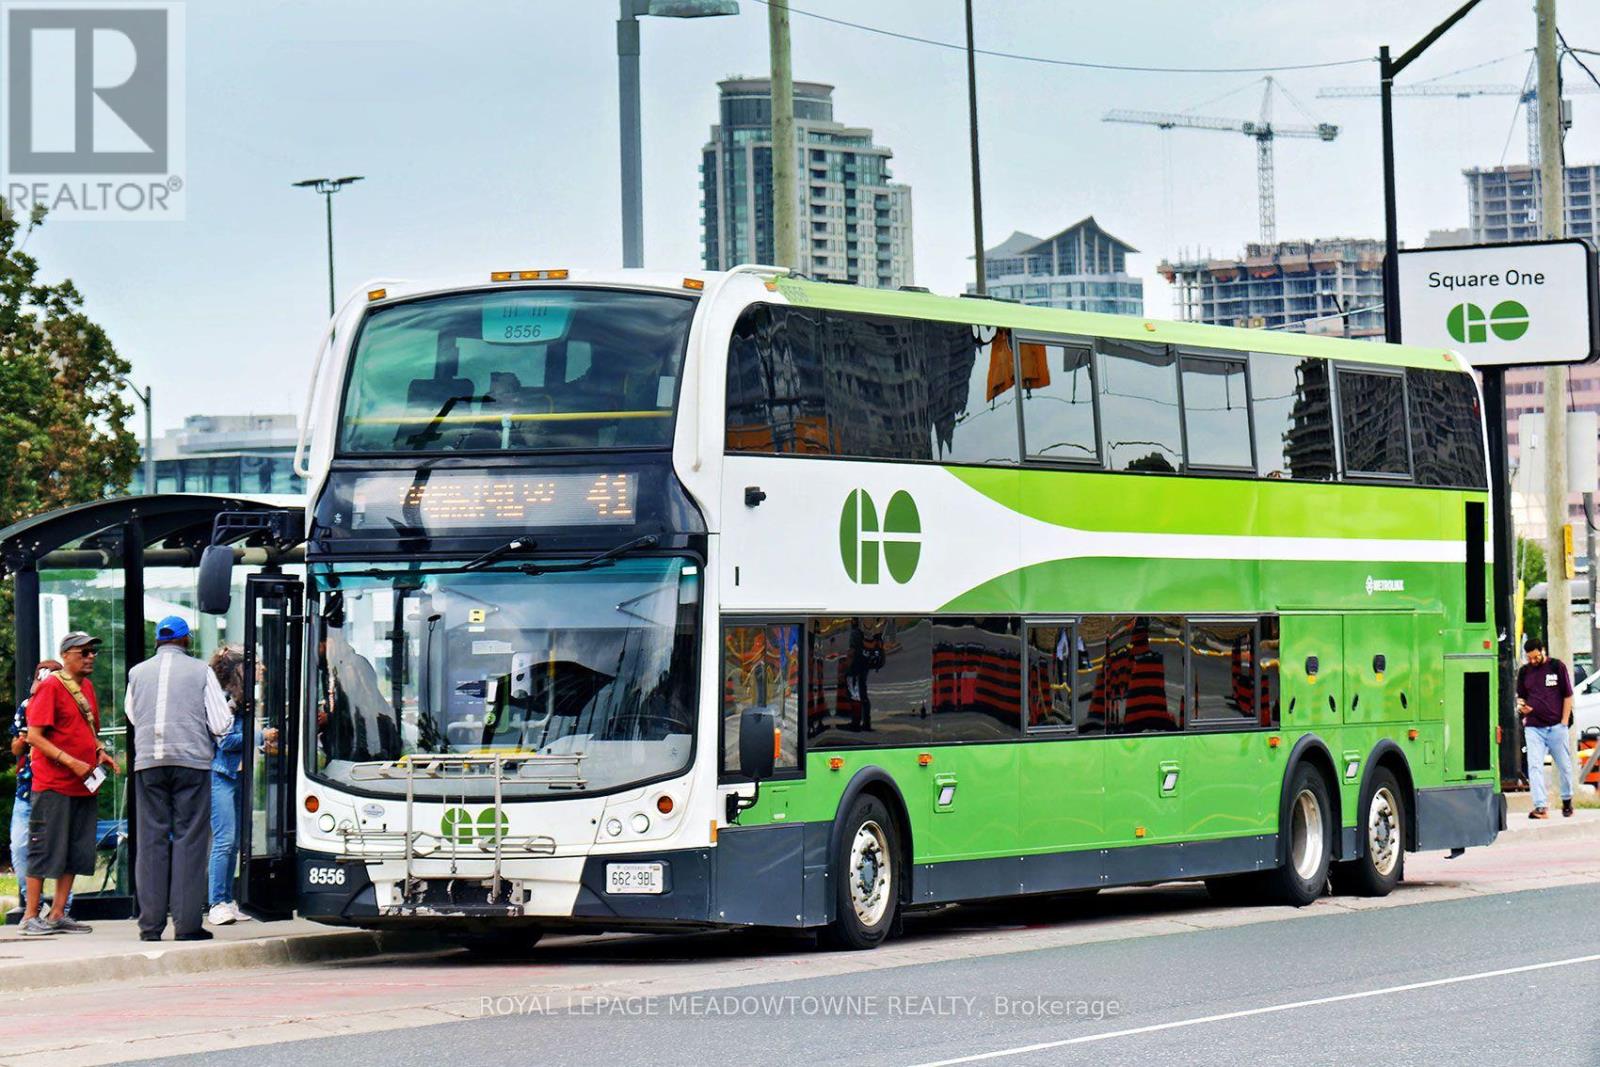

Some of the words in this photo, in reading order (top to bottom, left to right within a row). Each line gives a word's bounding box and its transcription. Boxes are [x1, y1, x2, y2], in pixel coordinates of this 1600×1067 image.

[1428, 271, 1500, 291] Square
[1505, 269, 1545, 286] One
[504, 324, 542, 340] 8556
[1446, 300, 1529, 344] GO
[586, 474, 633, 515] 41
[839, 487, 922, 585] GO
[309, 867, 346, 886] 8556
